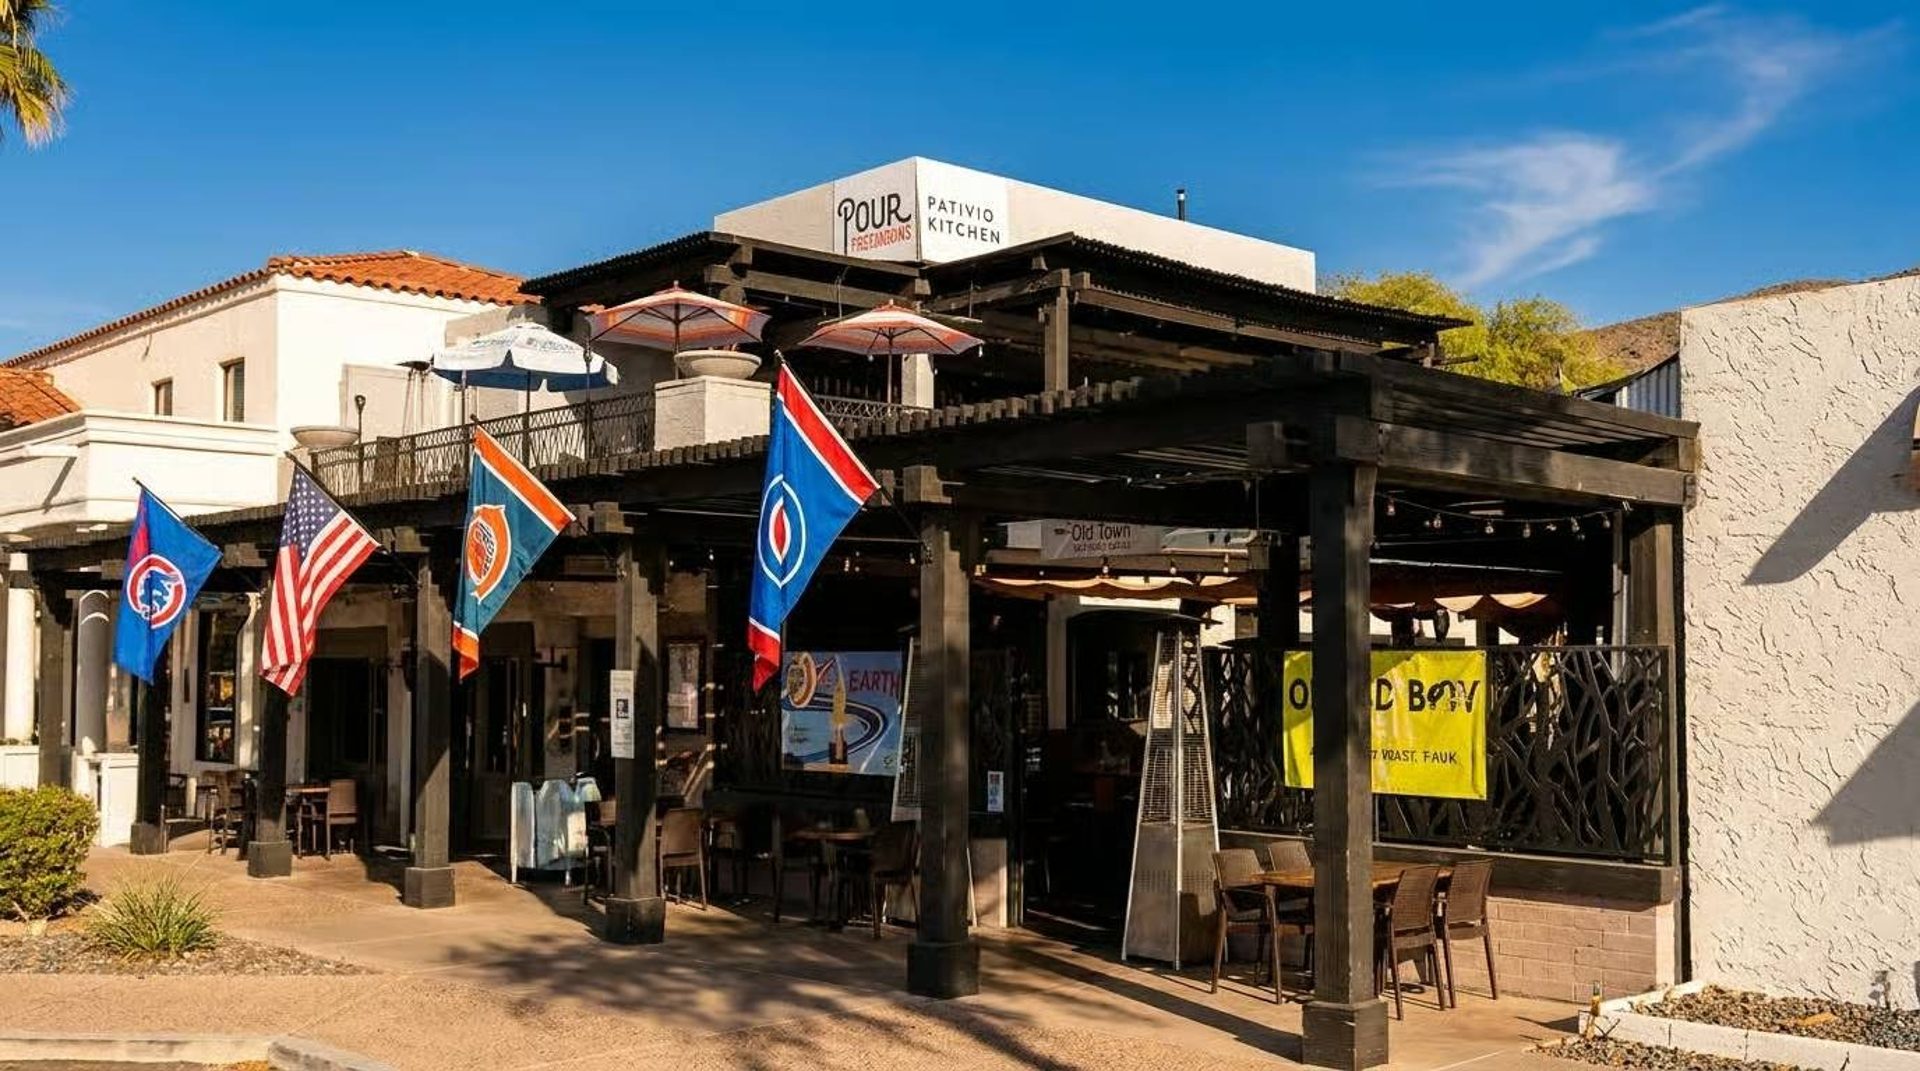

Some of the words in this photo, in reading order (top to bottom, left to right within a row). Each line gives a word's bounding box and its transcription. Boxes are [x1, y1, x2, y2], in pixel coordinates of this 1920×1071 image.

[927, 195, 994, 223] PATIVIO
[838, 193, 912, 256] POUR
[927, 216, 1001, 245] KITCHEN
[1071, 523, 1094, 542] Old
[1097, 523, 1131, 541] Town
[848, 670, 900, 700] EARTH
